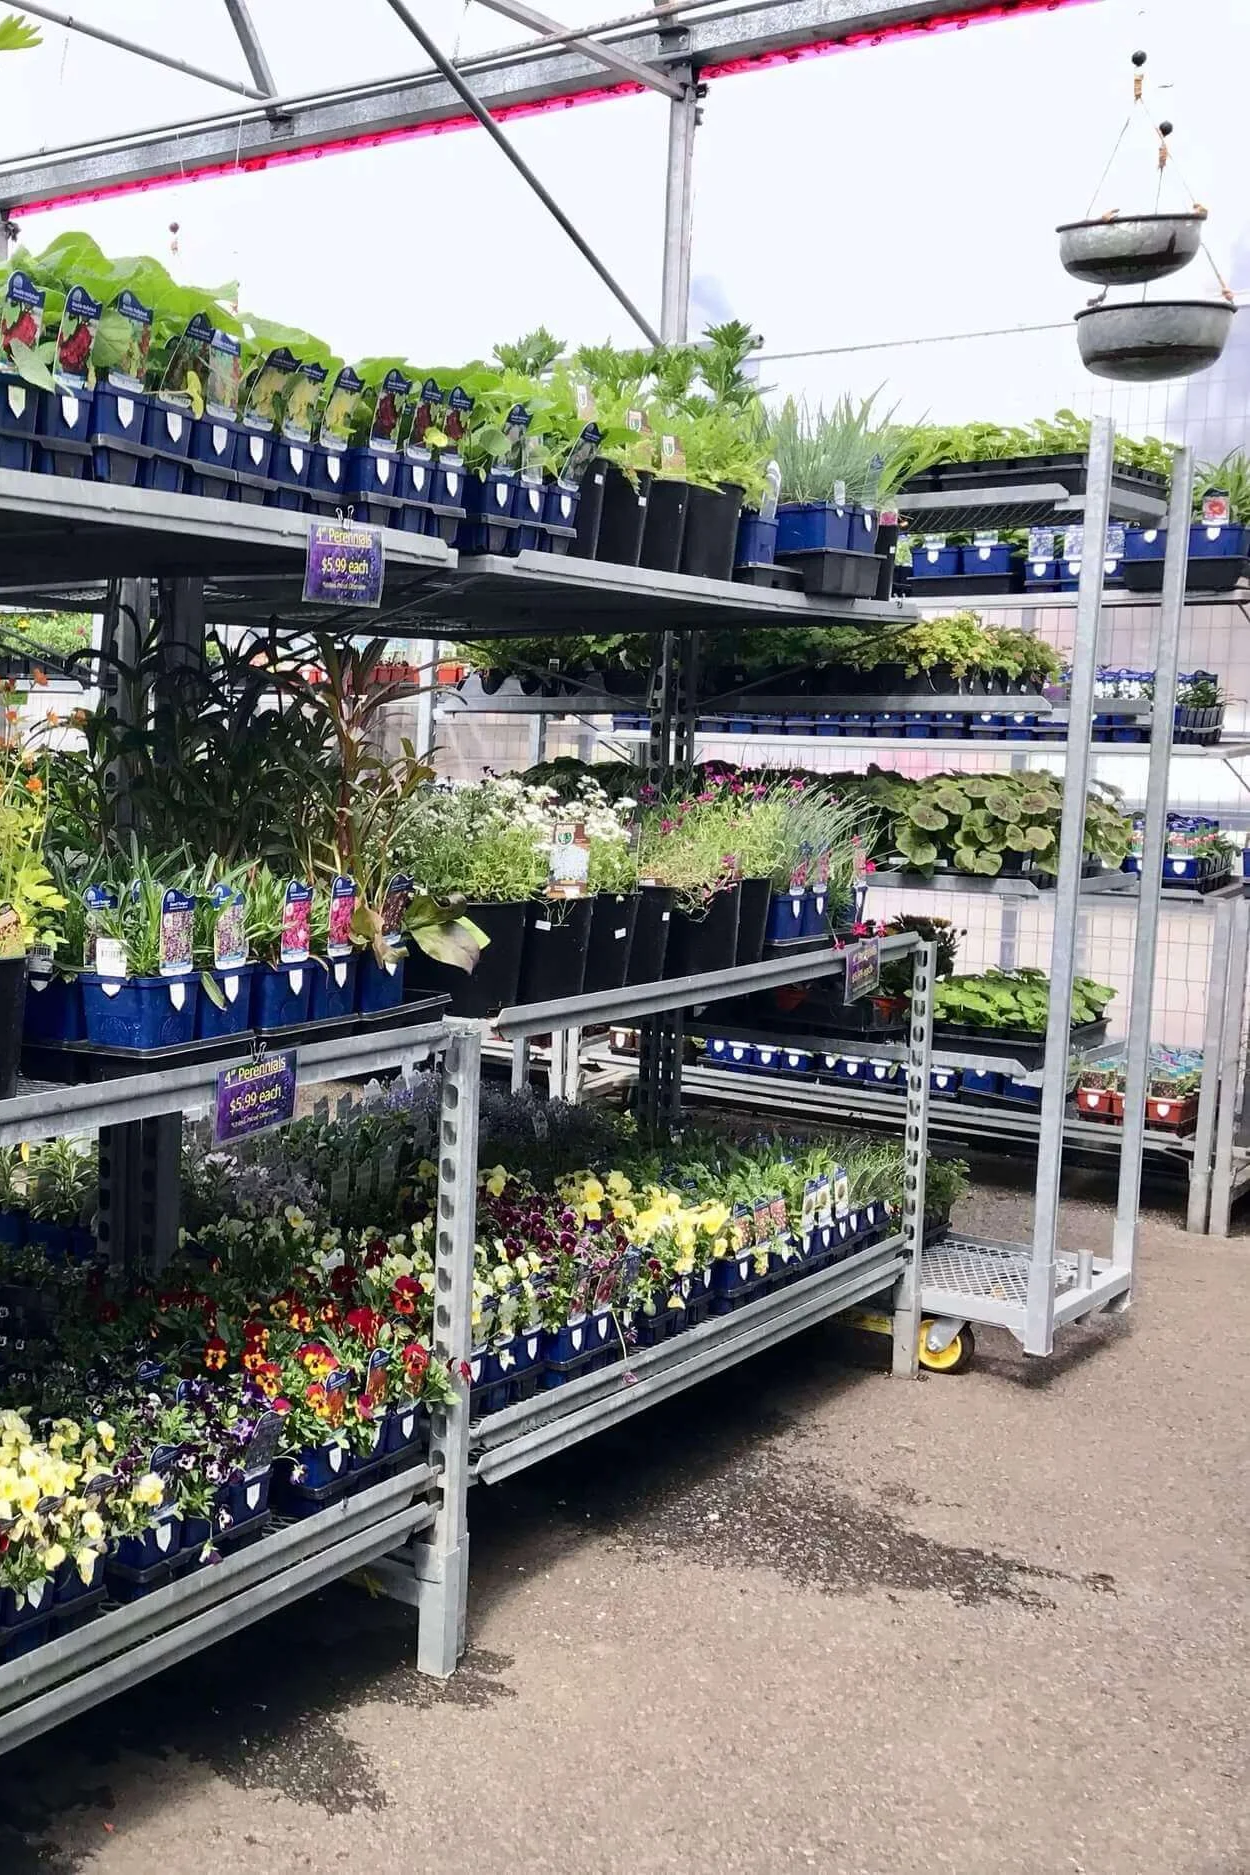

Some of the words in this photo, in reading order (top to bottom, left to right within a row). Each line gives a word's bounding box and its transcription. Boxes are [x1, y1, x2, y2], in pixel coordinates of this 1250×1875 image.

[329, 528, 372, 545] Perennials
[322, 556, 347, 574] $5.99
[348, 559, 369, 574] each
[238, 1056, 286, 1081] Perennials
[229, 1093, 257, 1116] $5.99
[259, 1084, 282, 1103] each
